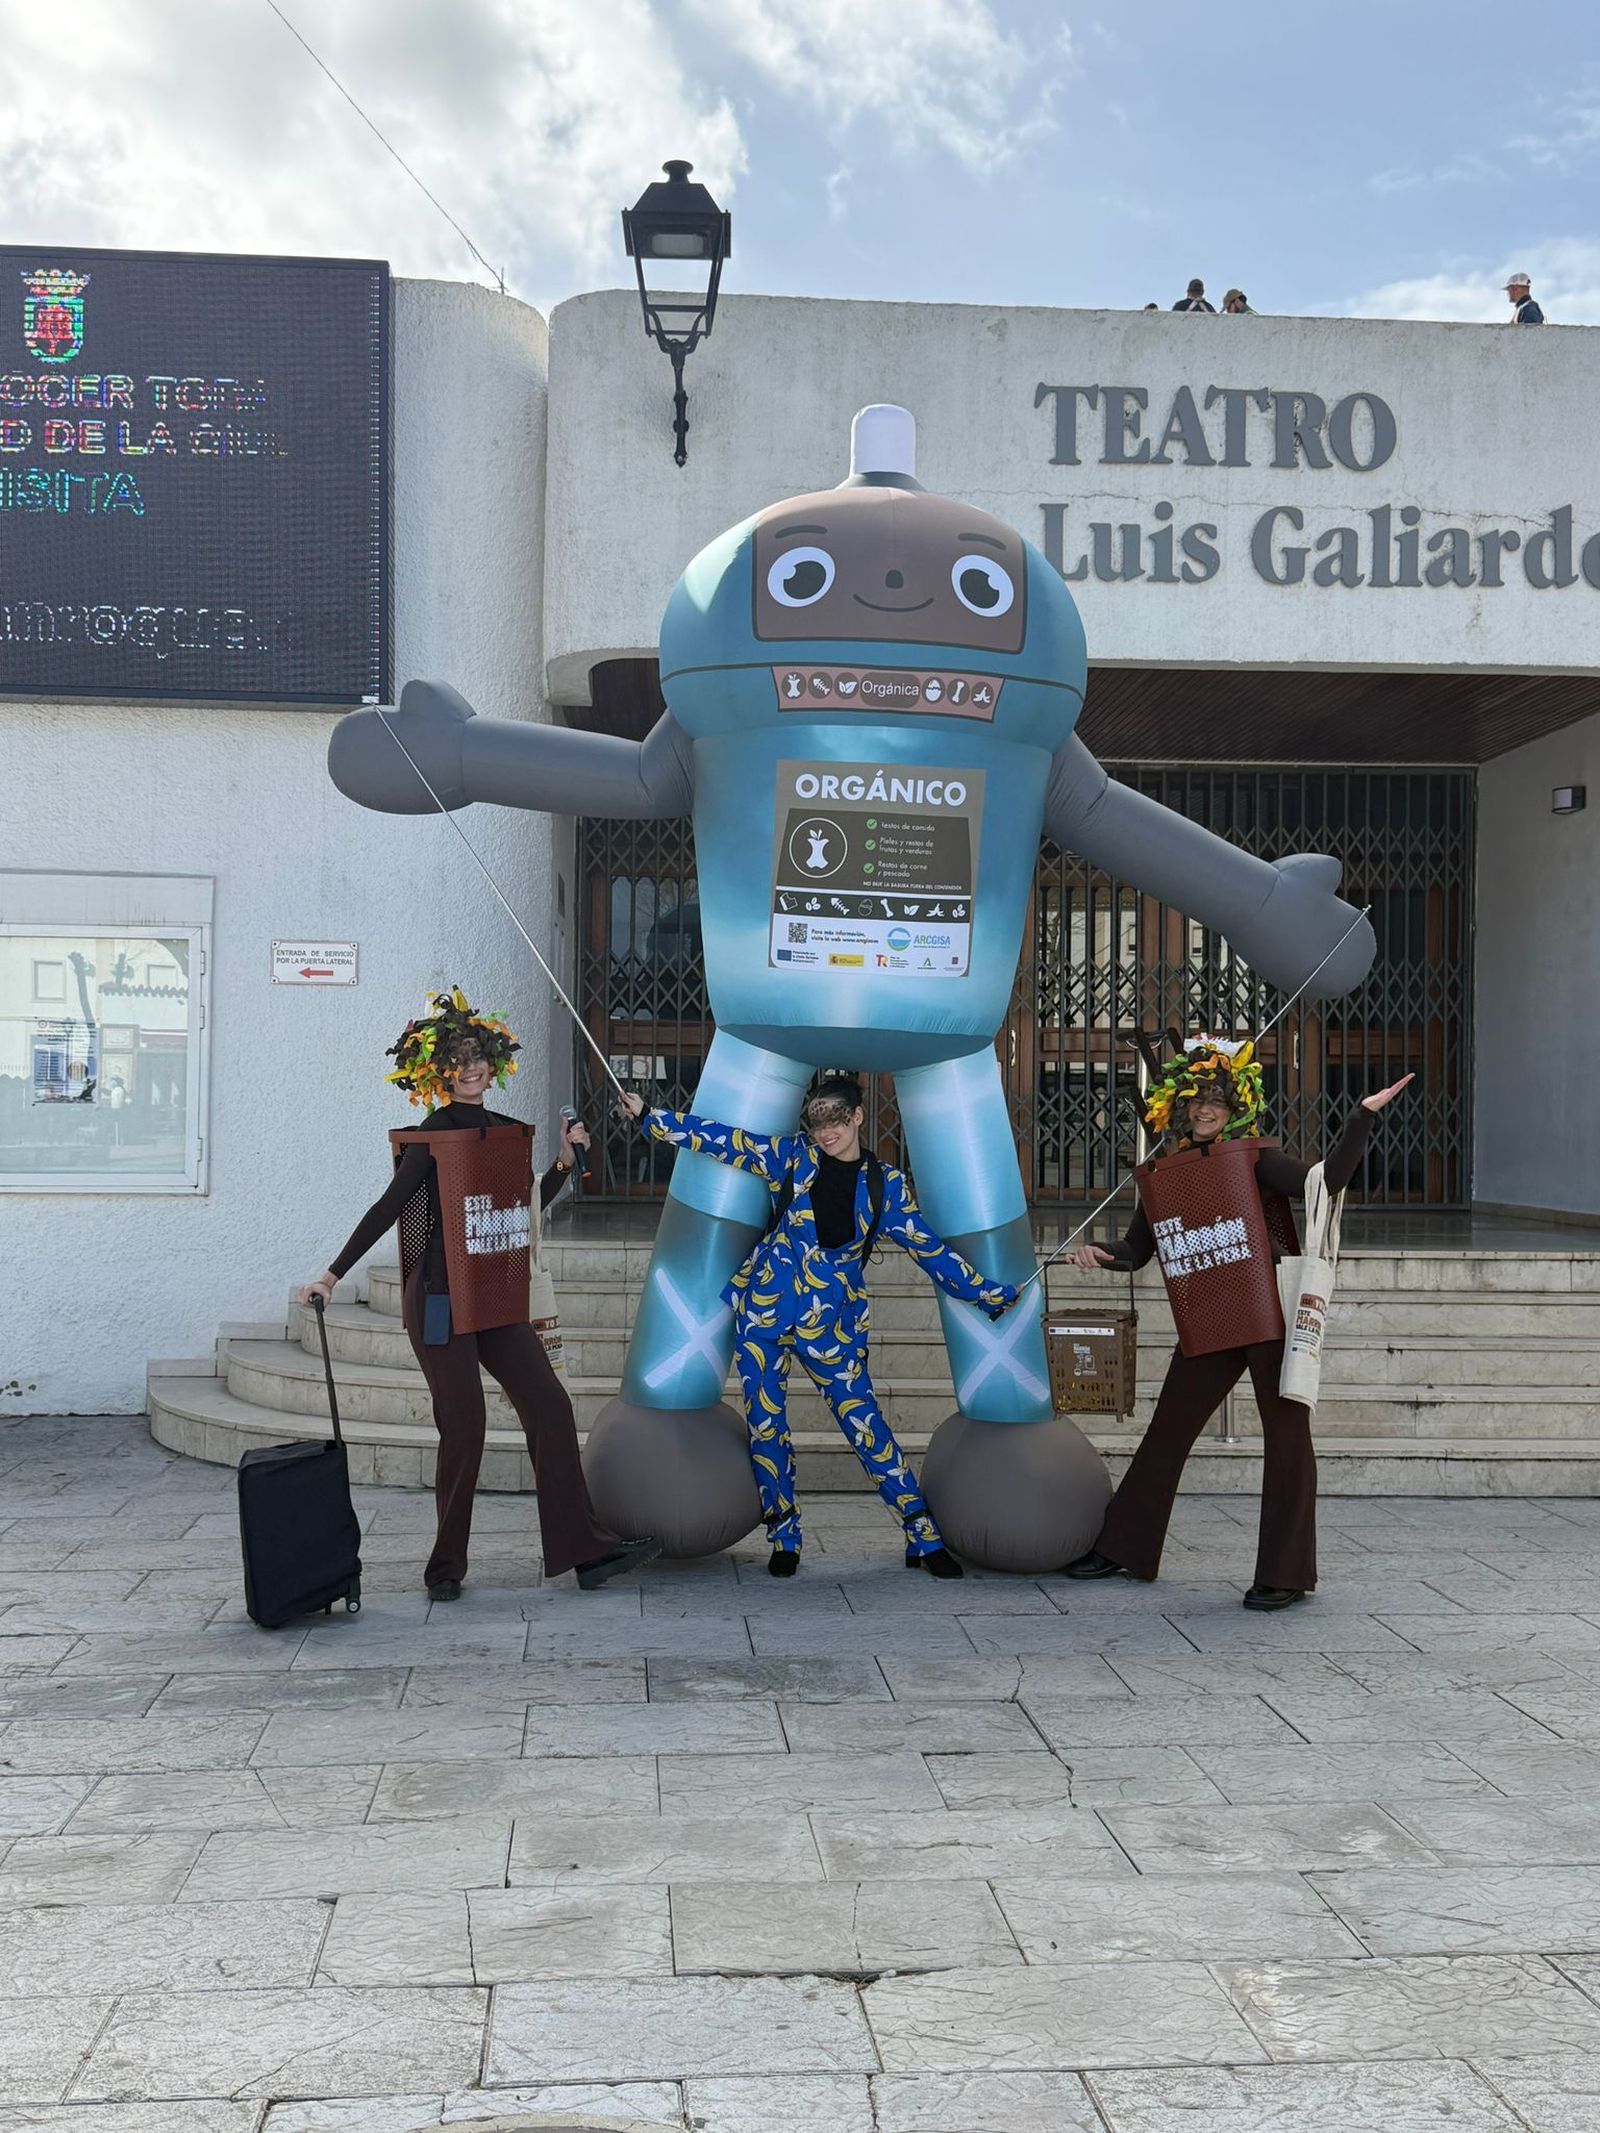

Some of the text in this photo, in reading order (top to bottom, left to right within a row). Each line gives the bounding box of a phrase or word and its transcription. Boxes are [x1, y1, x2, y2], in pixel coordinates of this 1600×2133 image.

[45, 419, 106, 454] DE
[118, 420, 177, 454] LA
[1034, 382, 1397, 471] TEATRO
[1039, 501, 1220, 583] Luis
[862, 681, 919, 698] Orgánica
[795, 769, 967, 807] ORGÁNICO
[276, 949, 307, 957] ENTRADA
[913, 935, 951, 945] ARCGISA
[1153, 1216, 1184, 1238] ESTE
[1193, 1252, 1214, 1271] LA
[1214, 1243, 1252, 1266] PENA
